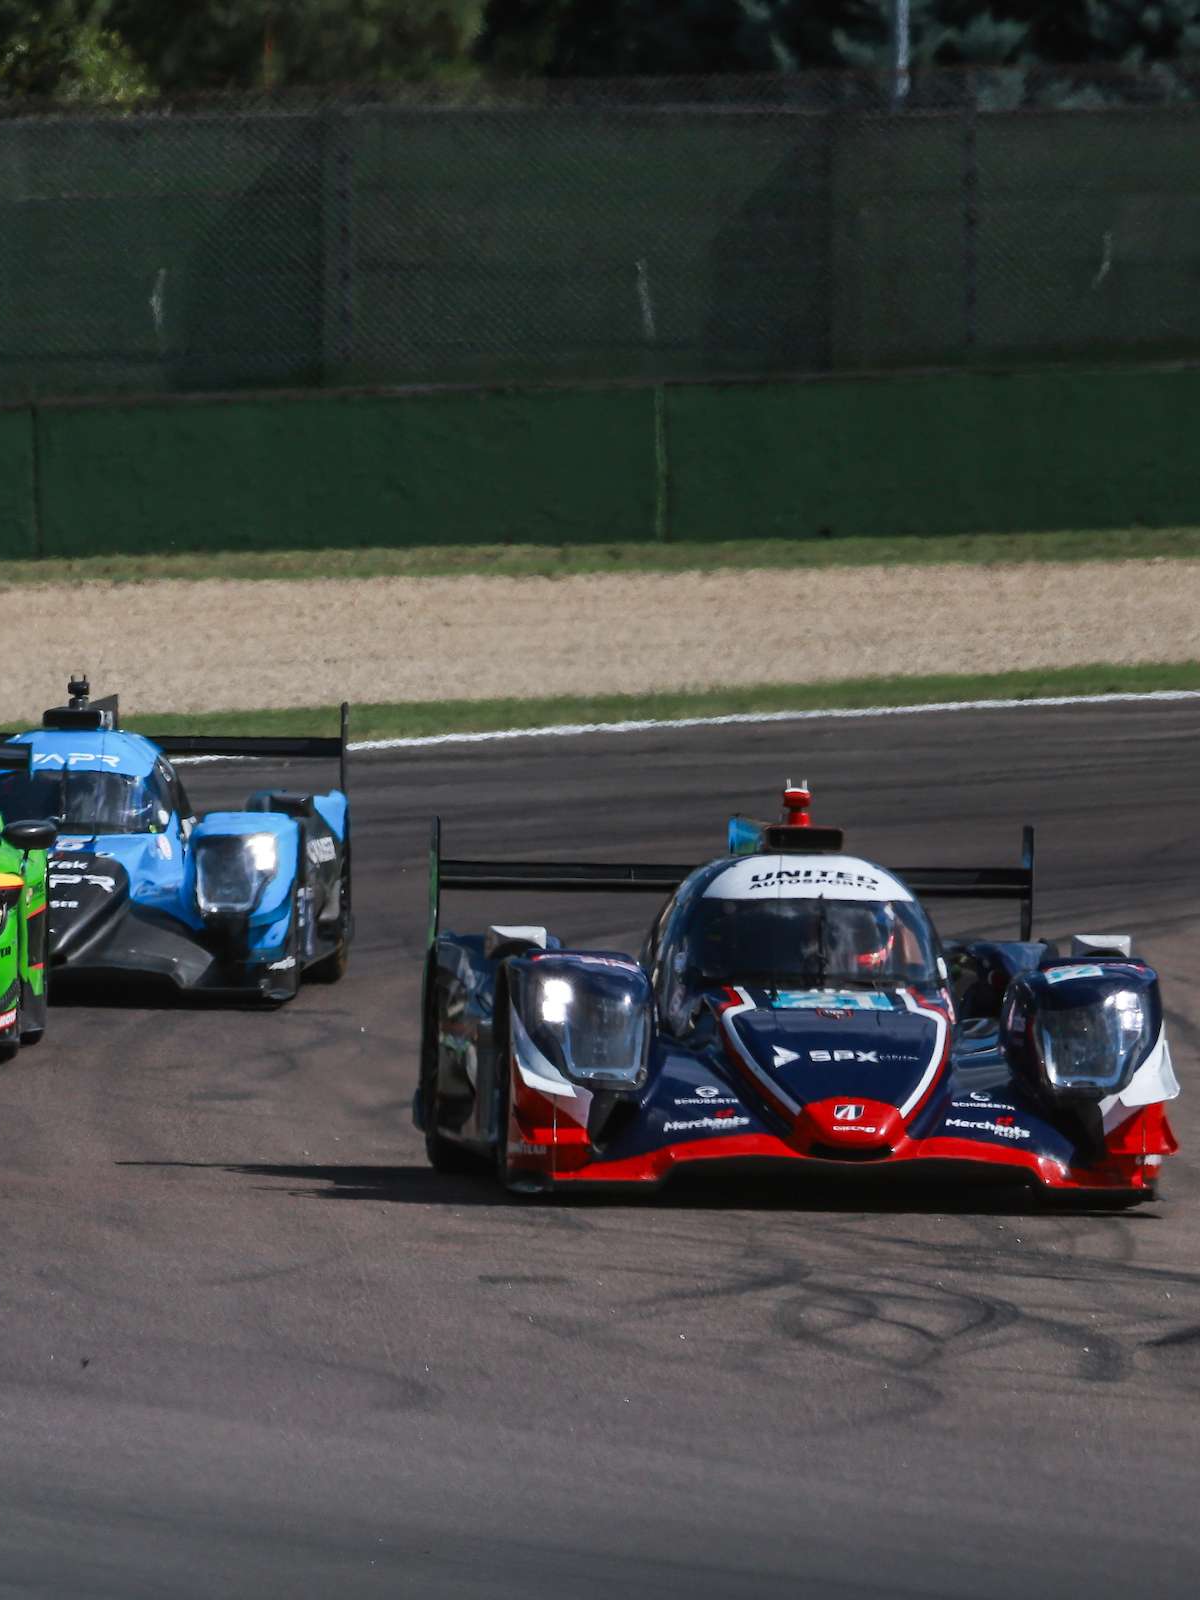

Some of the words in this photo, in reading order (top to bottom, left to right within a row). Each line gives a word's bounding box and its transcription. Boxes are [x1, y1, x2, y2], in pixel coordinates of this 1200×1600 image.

[749, 878, 877, 891] AUTOSPORTS
[751, 870, 879, 885] UNITED
[809, 1050, 879, 1063] SPX
[663, 1116, 750, 1132] Merchants
[945, 1118, 1031, 1138] Merchants
